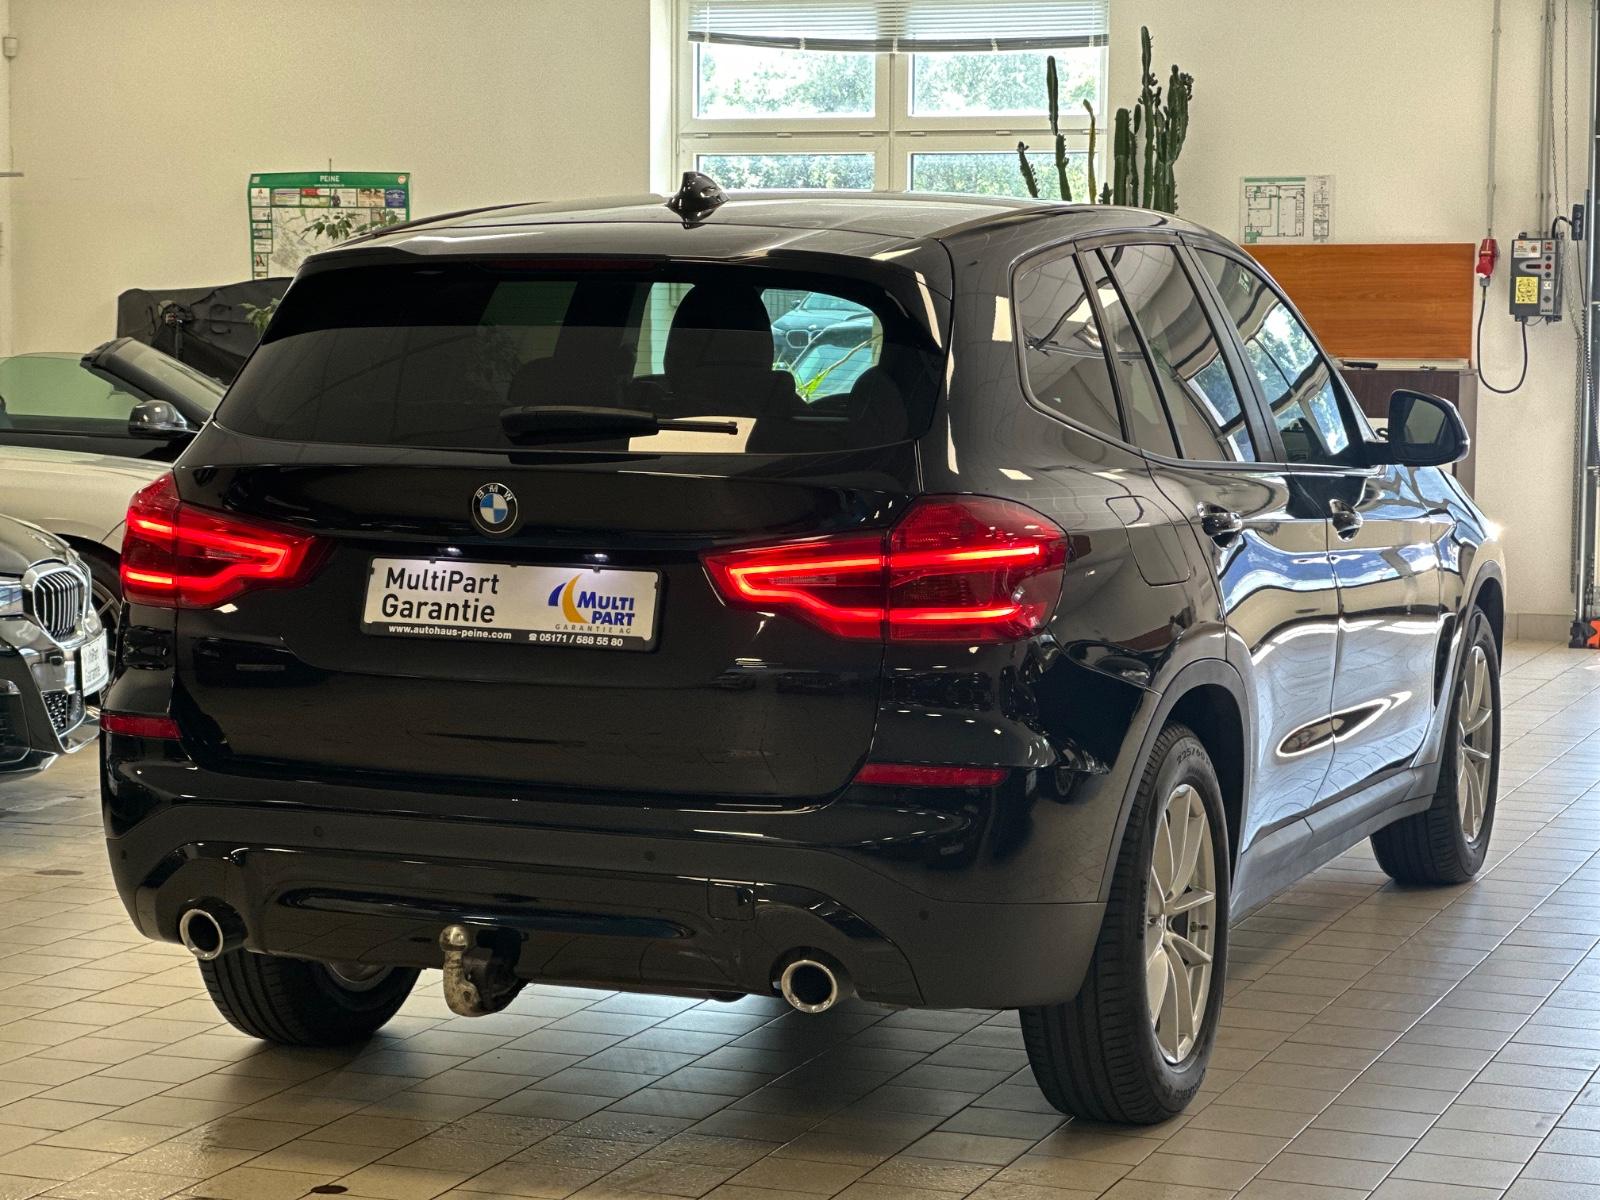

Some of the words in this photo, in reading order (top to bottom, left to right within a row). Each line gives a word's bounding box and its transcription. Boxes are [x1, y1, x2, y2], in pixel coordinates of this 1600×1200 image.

[476, 484, 513, 502] BMW
[385, 567, 500, 595] MultiPart
[381, 593, 495, 623] Garantie
[577, 591, 635, 611] MULTI
[591, 610, 635, 626] PART
[388, 625, 512, 640] www.autohaus-peine.com
[555, 623, 613, 633] GARANTIE
[539, 633, 567, 643] 05171
[576, 635, 594, 645] 588
[595, 636, 609, 645] 55
[610, 637, 623, 647] 80
